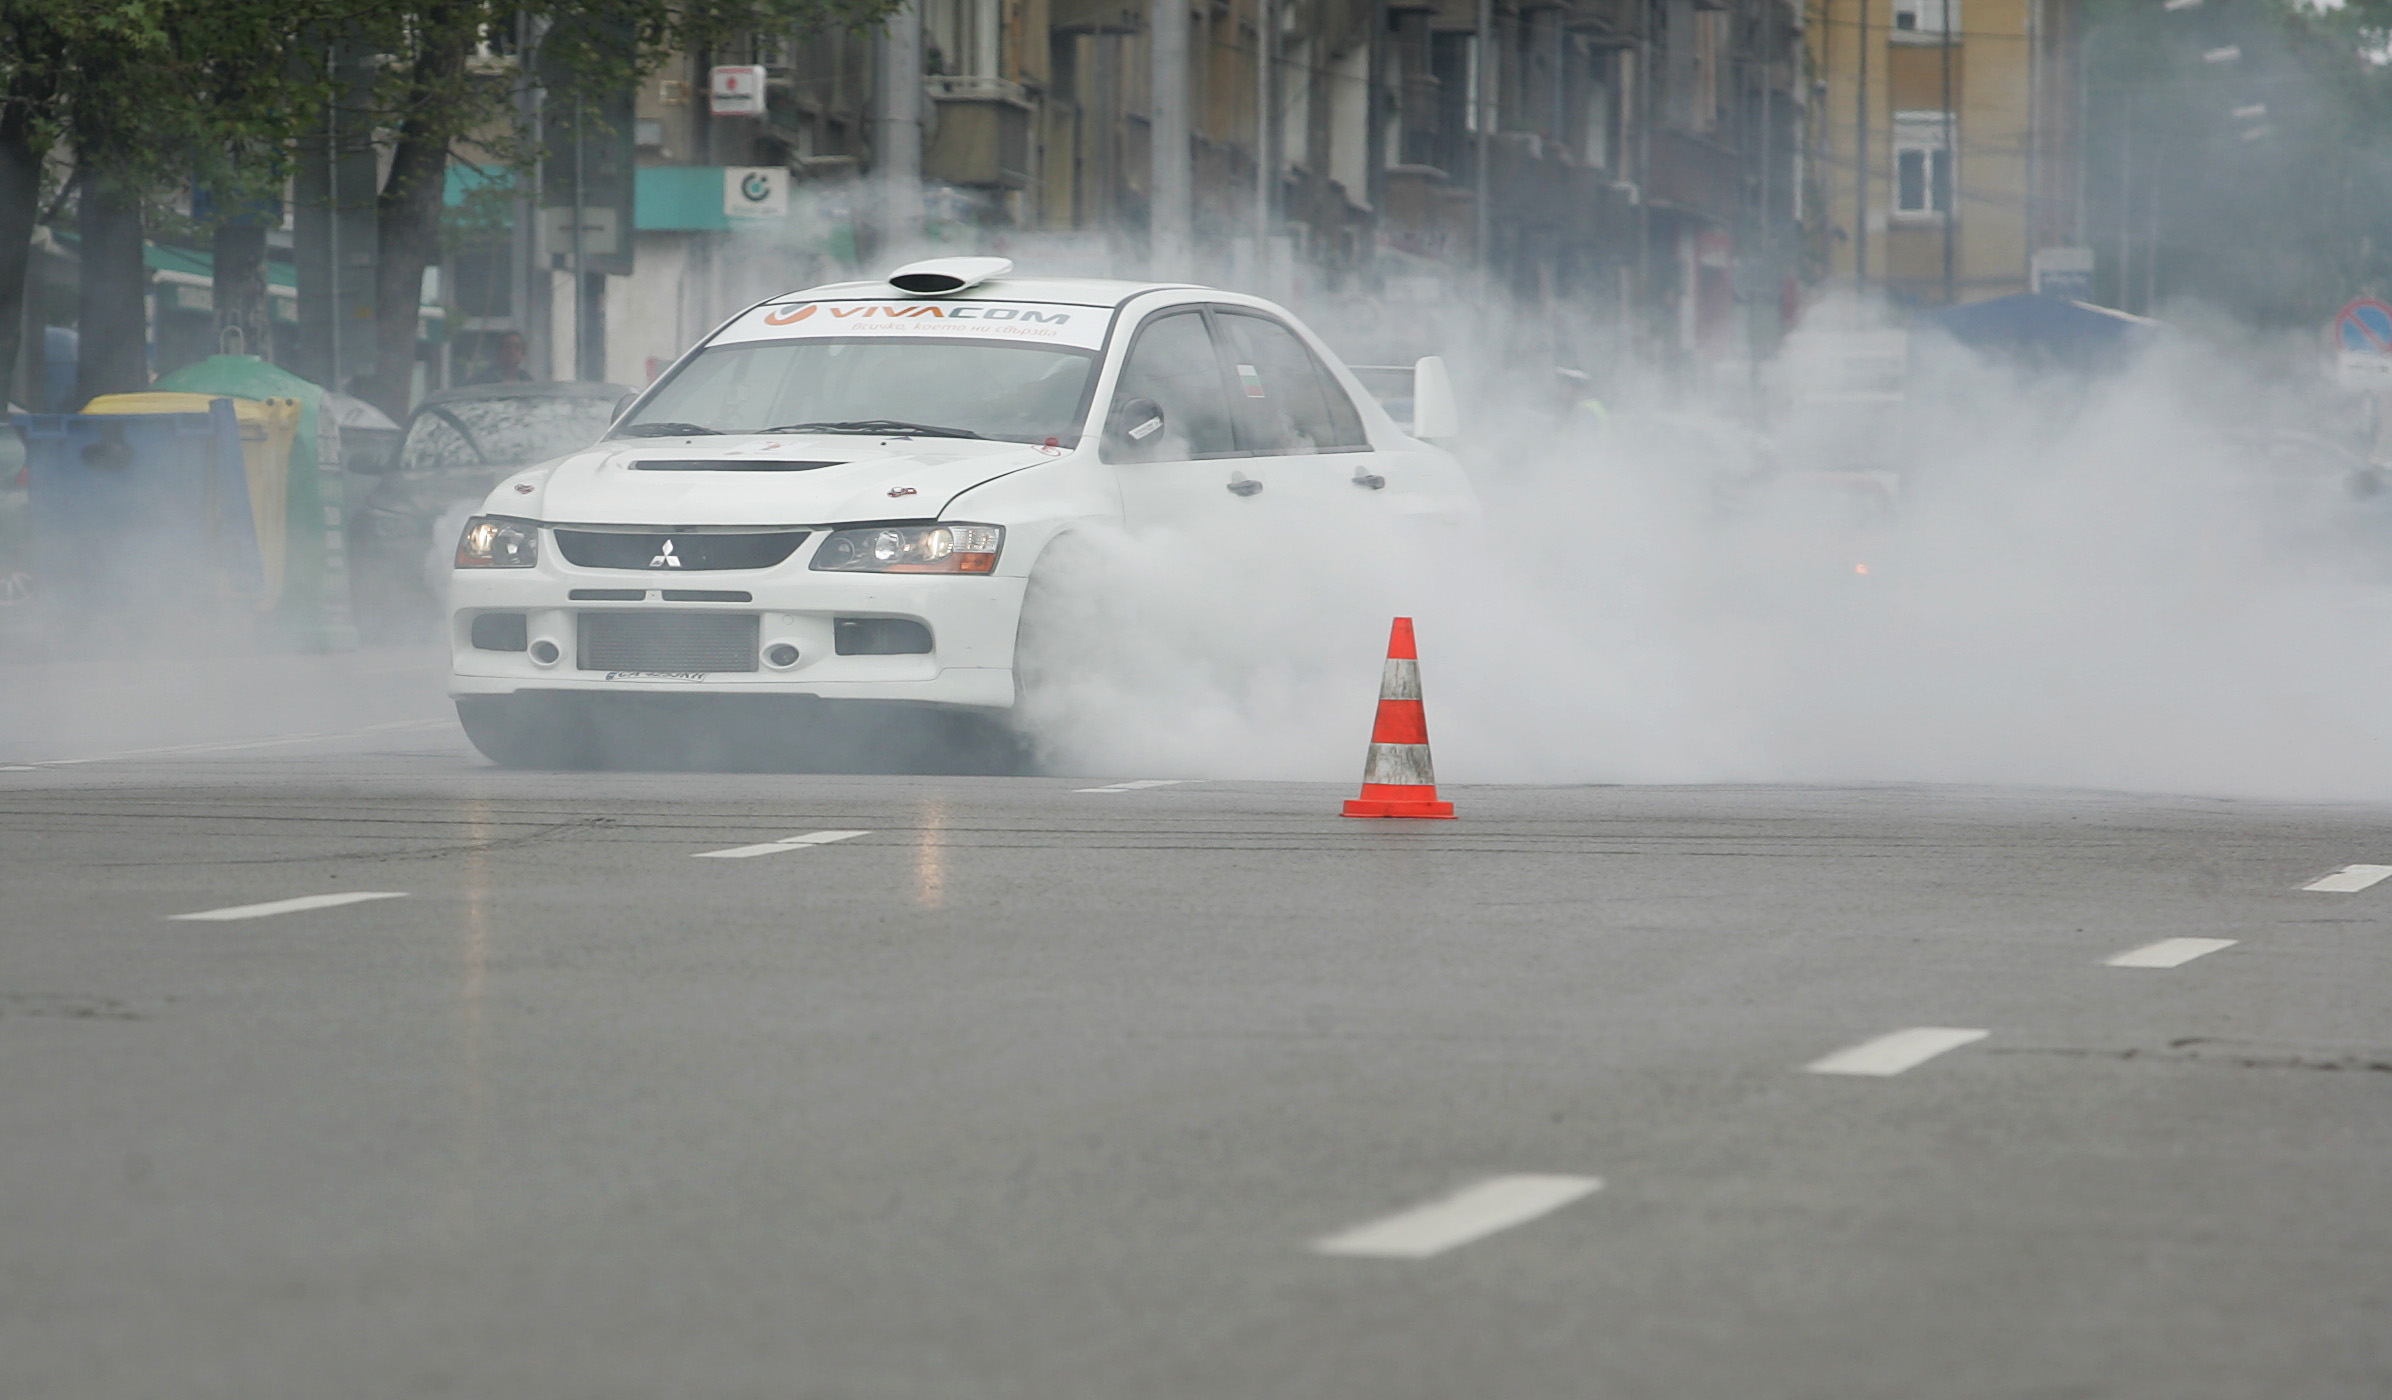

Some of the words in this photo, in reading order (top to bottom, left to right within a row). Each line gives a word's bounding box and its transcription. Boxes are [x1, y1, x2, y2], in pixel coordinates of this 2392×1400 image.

[829, 306, 1071, 325] VIVACOM
[913, 322, 967, 332] което
[970, 325, 991, 333] ни
[995, 325, 1058, 337] свързва
